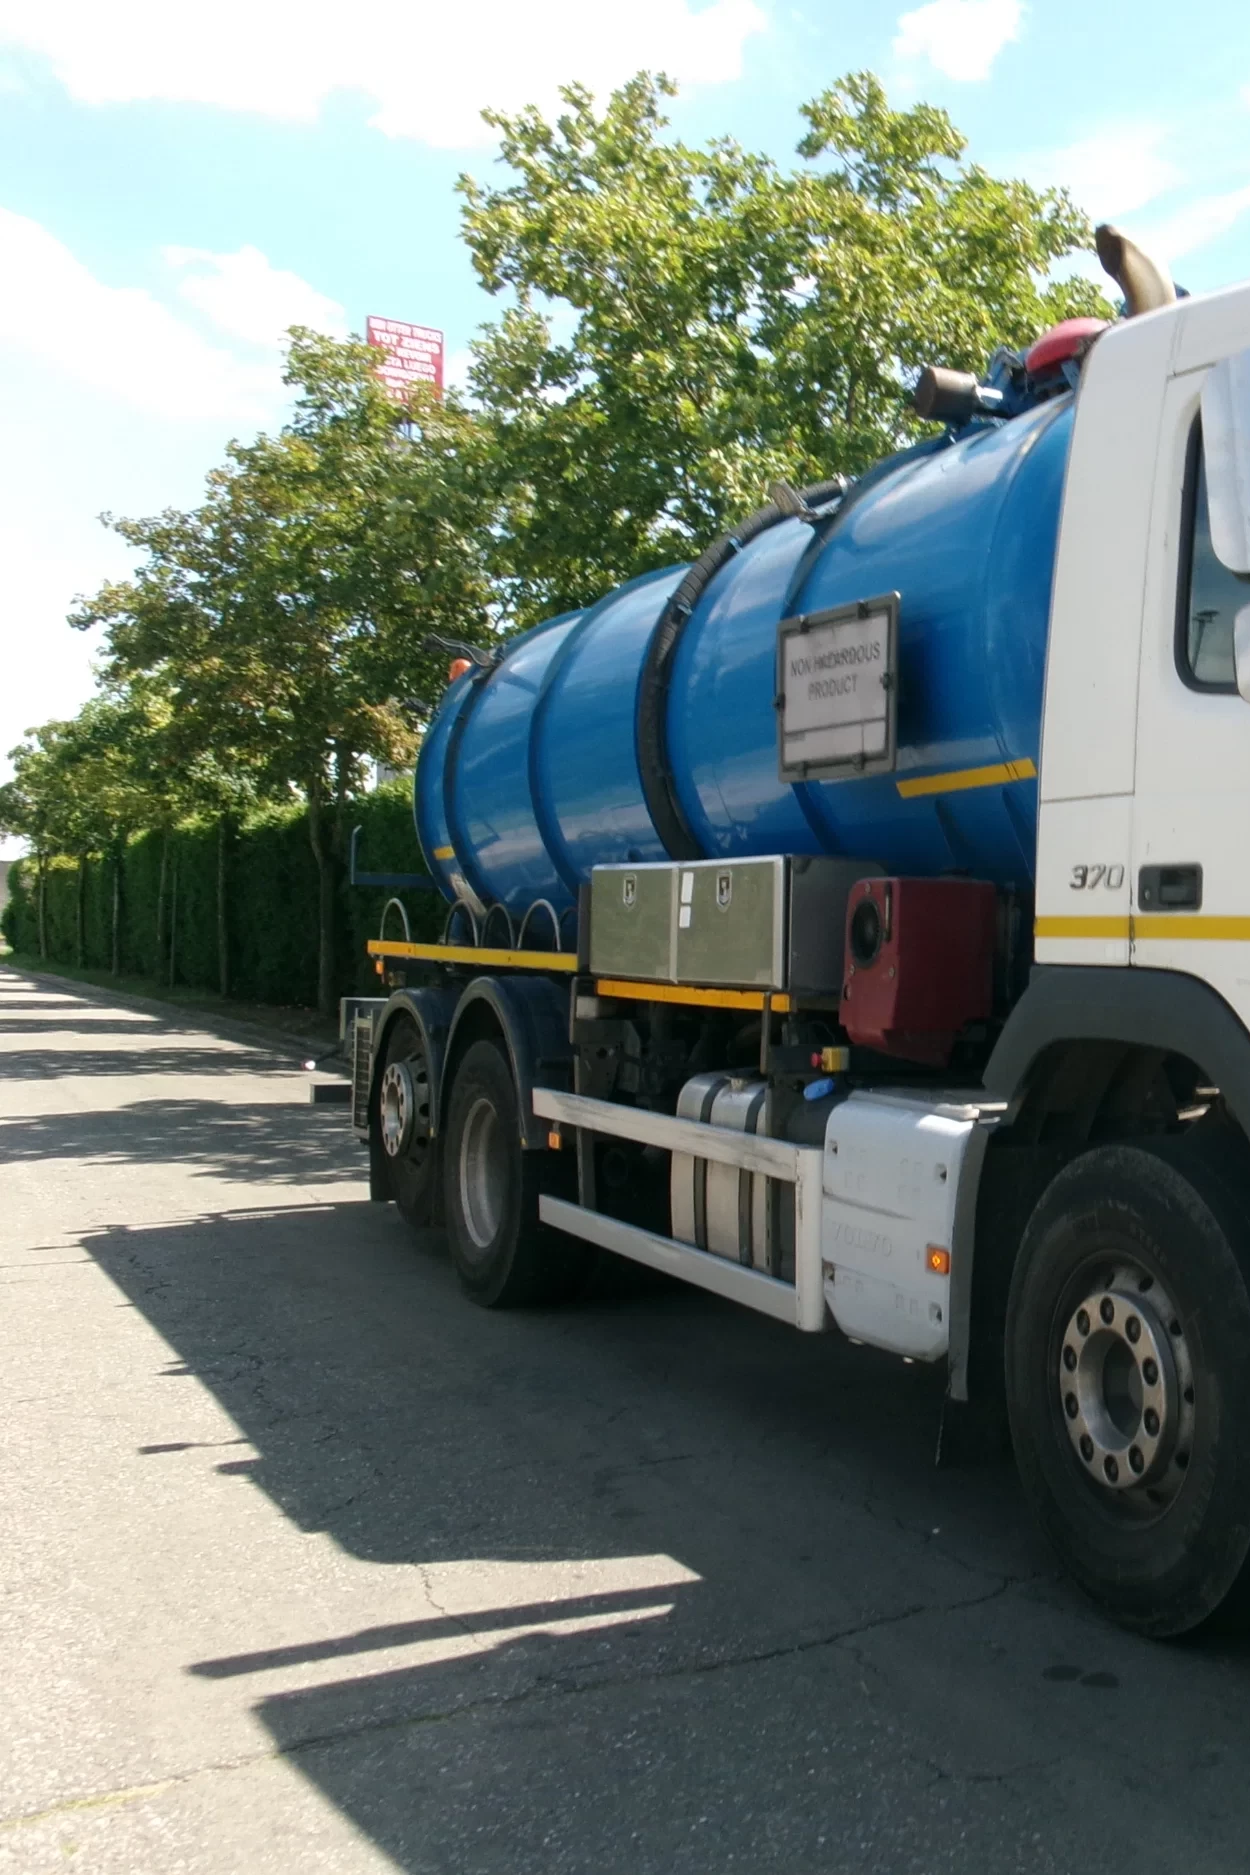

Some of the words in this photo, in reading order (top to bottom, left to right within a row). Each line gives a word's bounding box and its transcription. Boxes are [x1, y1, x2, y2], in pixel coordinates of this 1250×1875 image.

[372, 330, 399, 346] TOT
[401, 337, 440, 354] ZIENS
[790, 657, 812, 677] NON
[808, 673, 858, 701] PRODUCT
[1069, 864, 1125, 890] 370
